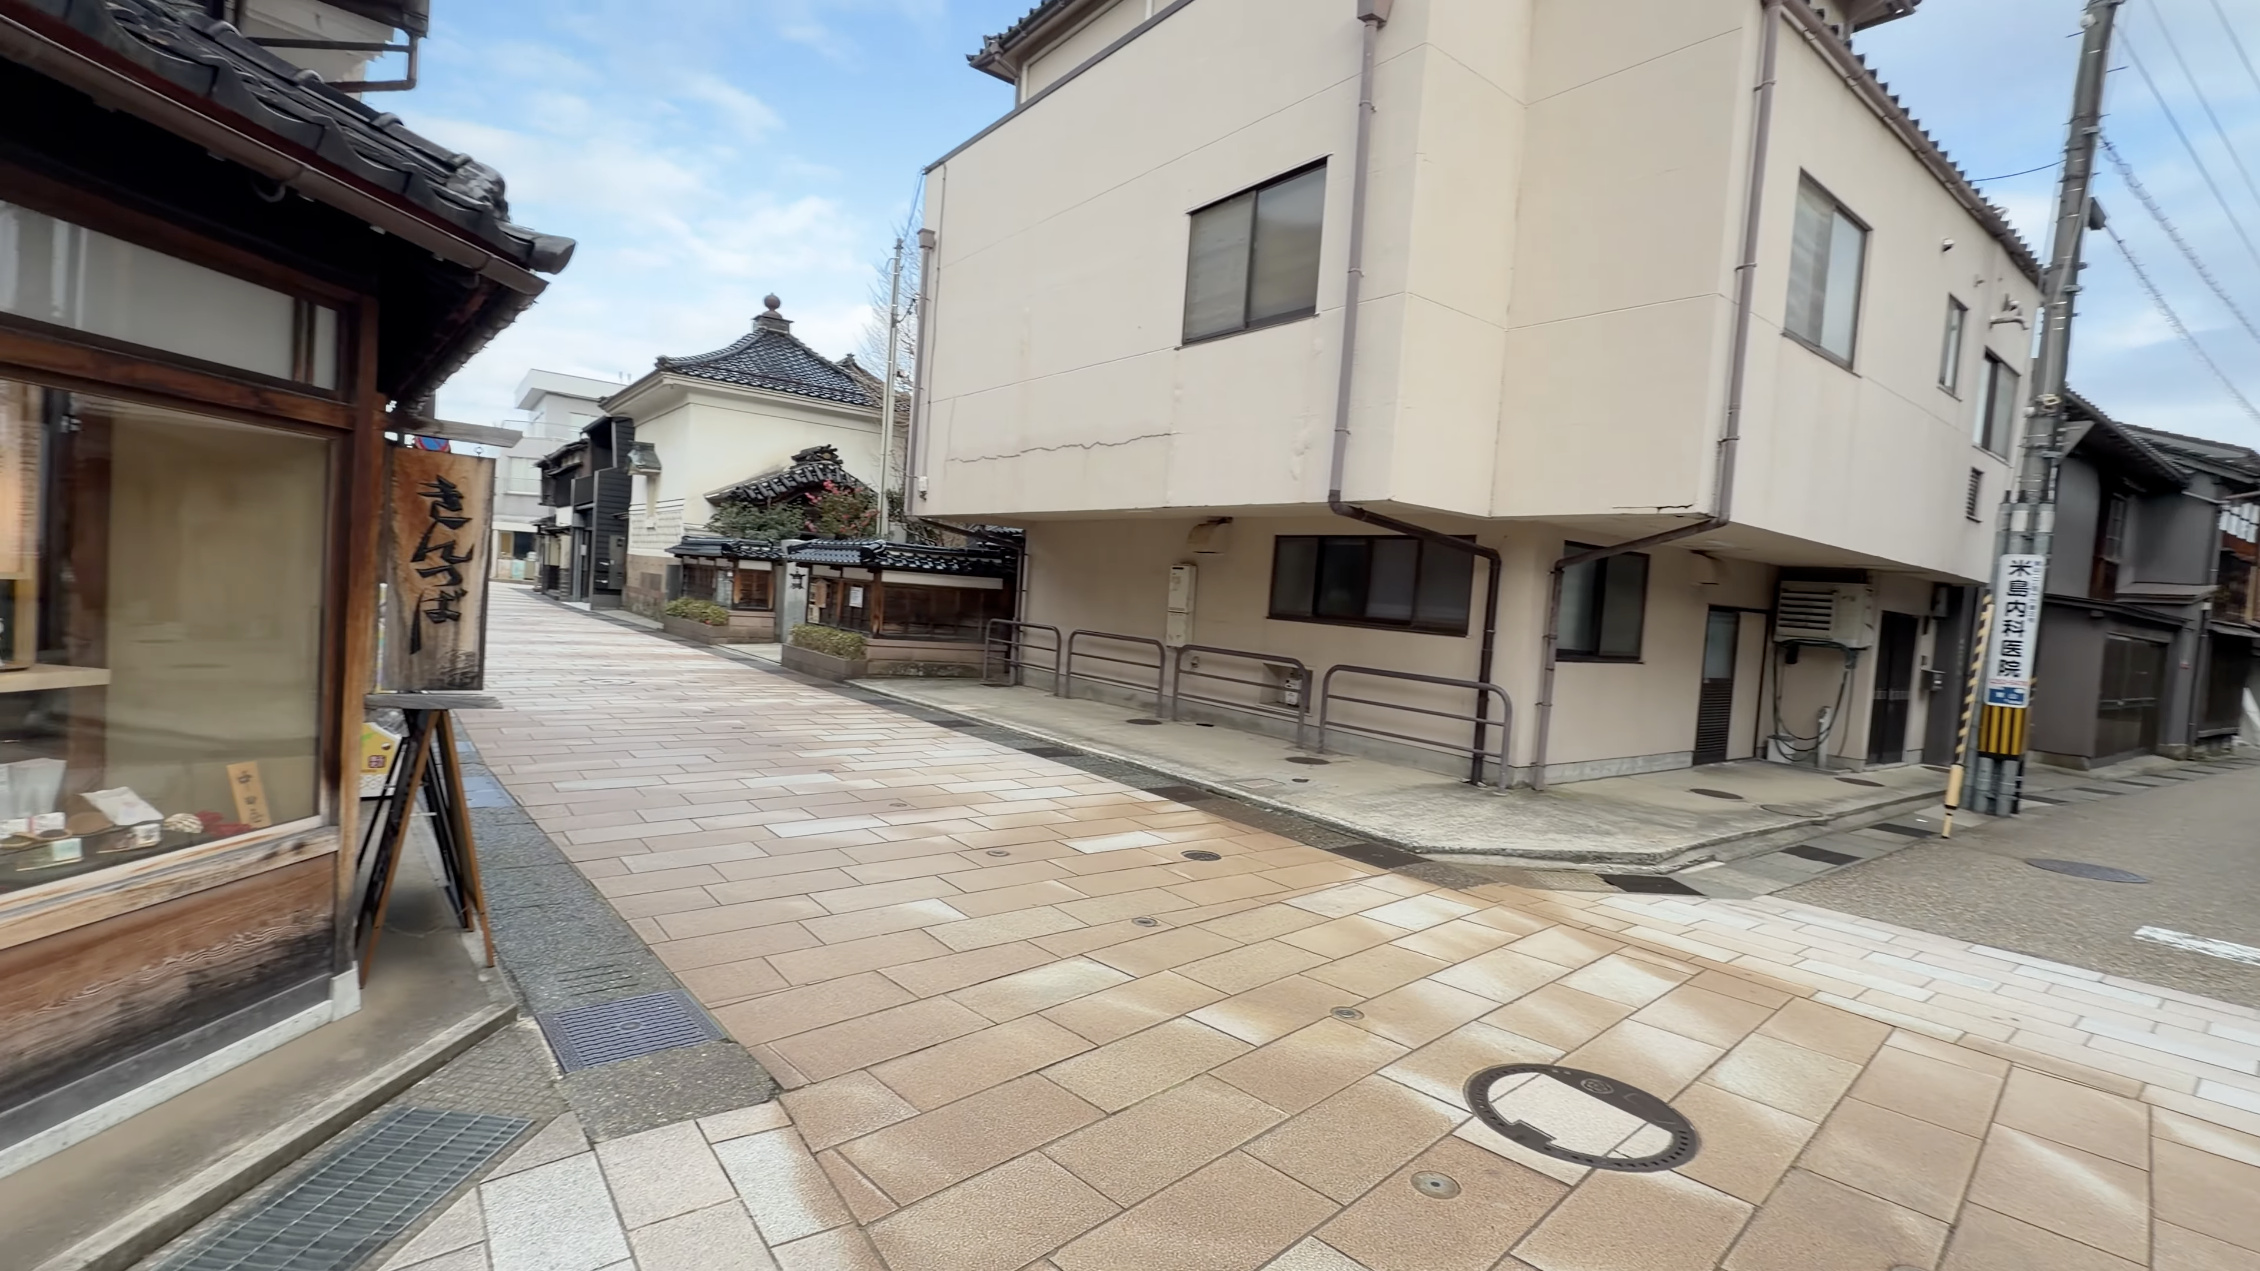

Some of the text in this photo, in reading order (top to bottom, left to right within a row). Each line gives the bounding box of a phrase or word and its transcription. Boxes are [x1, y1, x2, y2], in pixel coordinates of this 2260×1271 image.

[410, 474, 475, 655] きんつば
[1996, 558, 2033, 679] 米島内科医院
